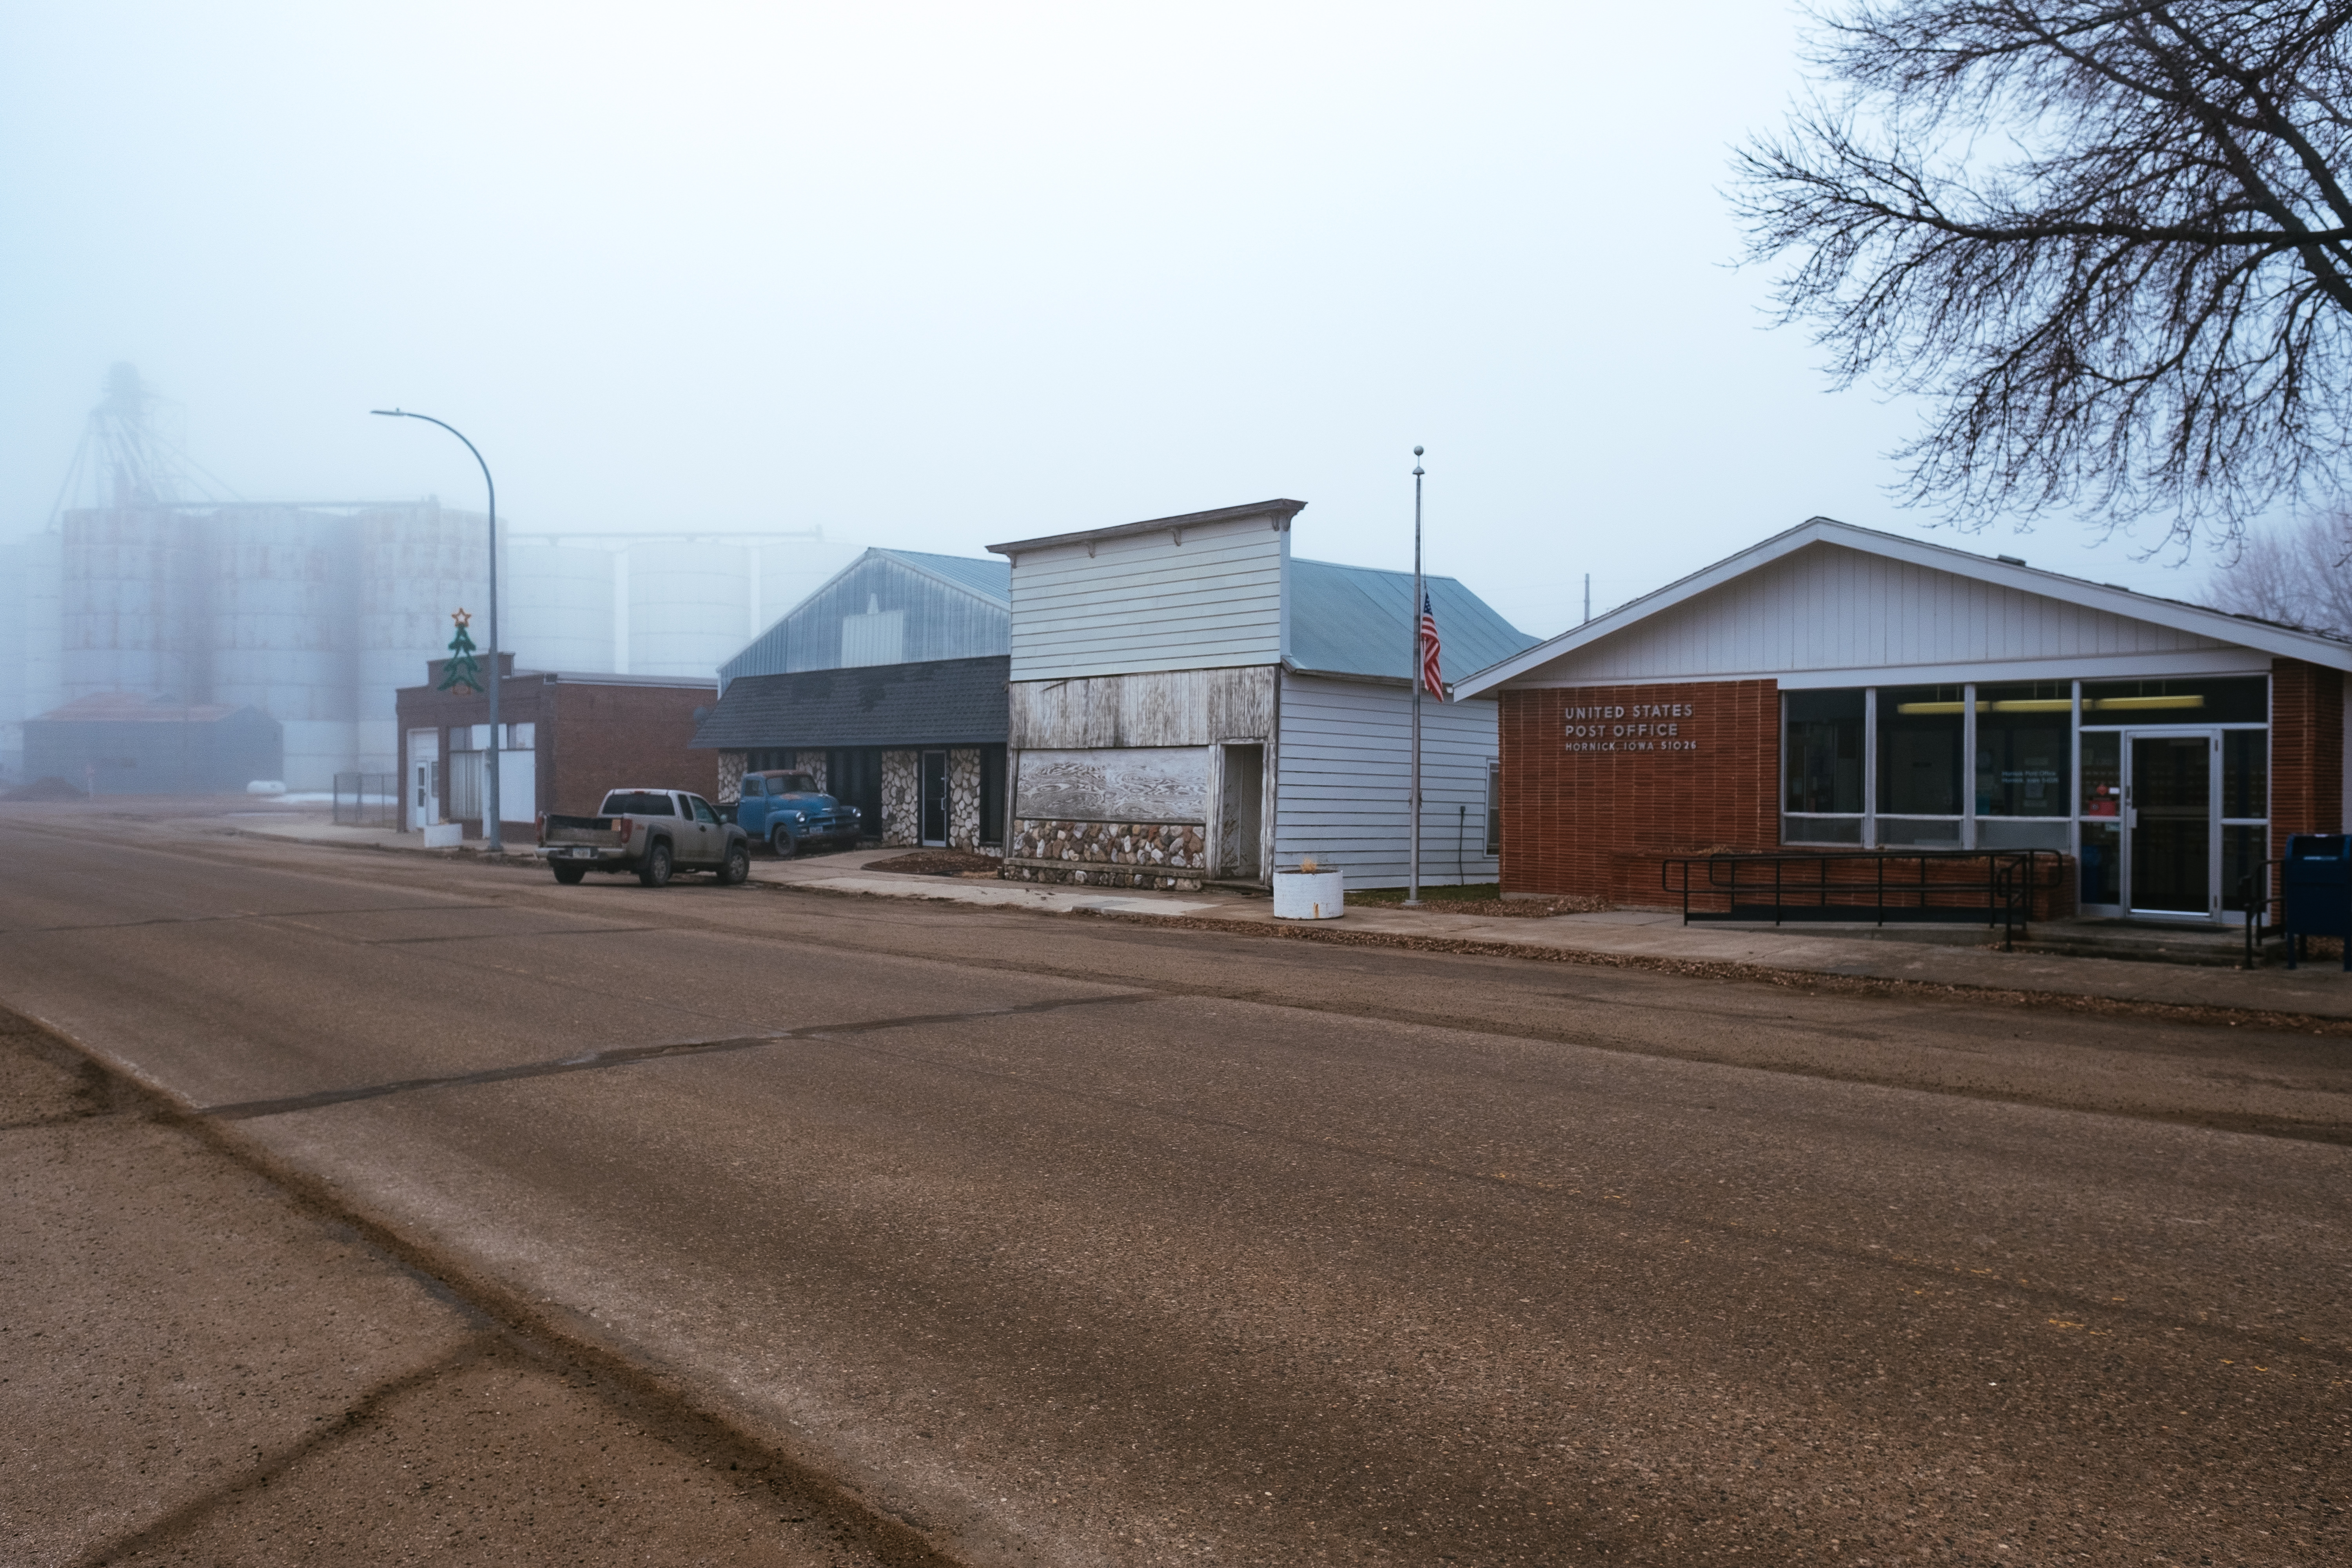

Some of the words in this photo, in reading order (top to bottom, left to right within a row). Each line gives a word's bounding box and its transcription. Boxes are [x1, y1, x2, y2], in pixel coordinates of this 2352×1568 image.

[1565, 706, 1624, 719] UNITED
[1633, 704, 1693, 717] STATES
[1565, 725, 1606, 737] POST
[1613, 723, 1678, 737] OFFICE
[1623, 742, 1654, 751] IOWA
[1661, 740, 1697, 751] 51026
